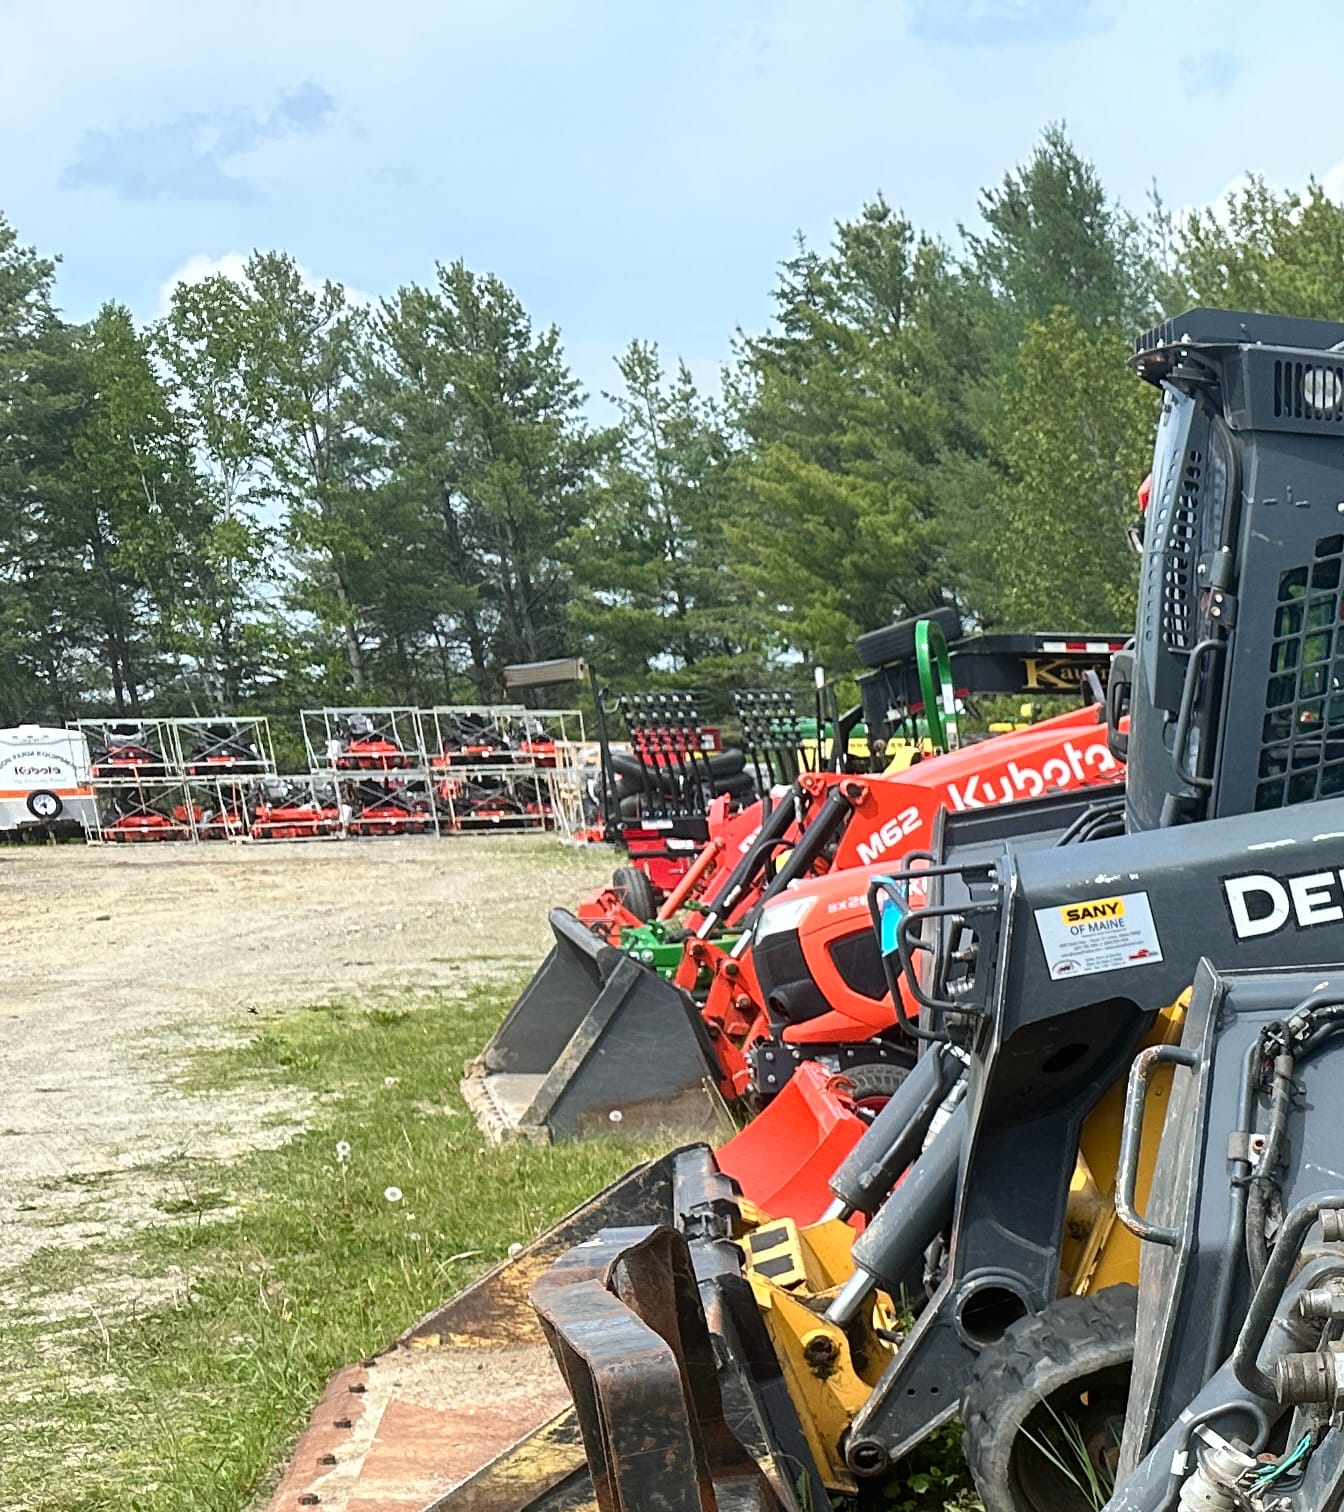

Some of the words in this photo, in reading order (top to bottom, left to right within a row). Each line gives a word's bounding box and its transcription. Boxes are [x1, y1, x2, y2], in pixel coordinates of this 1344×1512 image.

[1020, 658, 1107, 688] Kau
[947, 741, 1116, 811] Kubota
[856, 805, 923, 866] M62
[1066, 901, 1120, 922] SANY
[1070, 924, 1085, 937] OF
[1088, 917, 1126, 933] MAINE
